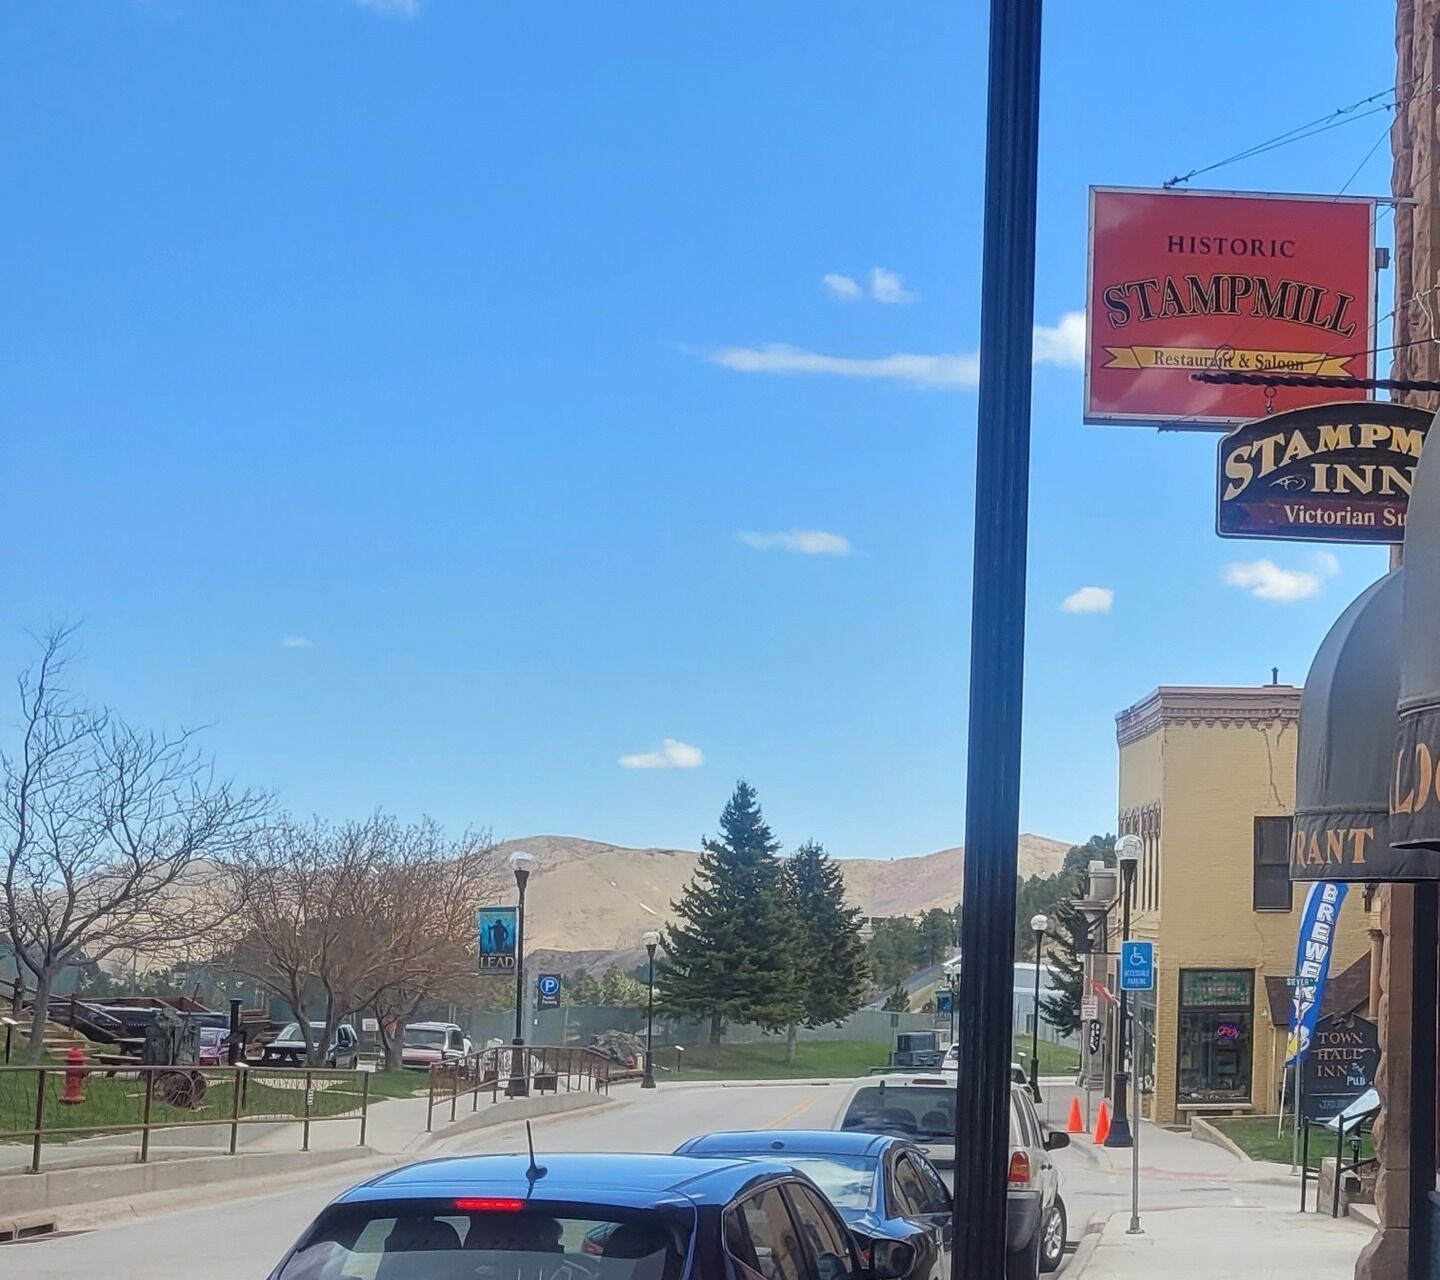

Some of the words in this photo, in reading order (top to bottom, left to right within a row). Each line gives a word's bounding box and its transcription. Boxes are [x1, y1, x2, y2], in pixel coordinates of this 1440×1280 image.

[1167, 235, 1296, 258] HISTORIC
[1103, 274, 1356, 338] STAMPMILL
[1154, 350, 1233, 368] Restaurant
[1238, 352, 1250, 368] &
[1255, 354, 1305, 371] Saloon
[1310, 463, 1417, 496] INN
[1283, 504, 1375, 526] Victorian
[1292, 883, 1338, 1020] BREWERY
[480, 957, 514, 968] LEAD
[1217, 1026, 1241, 1038] OPEN
[1316, 1032, 1364, 1045] TOWN
[1318, 1048, 1364, 1060] HALL
[1317, 1065, 1348, 1077] INN
[1346, 1076, 1366, 1086] PUB
